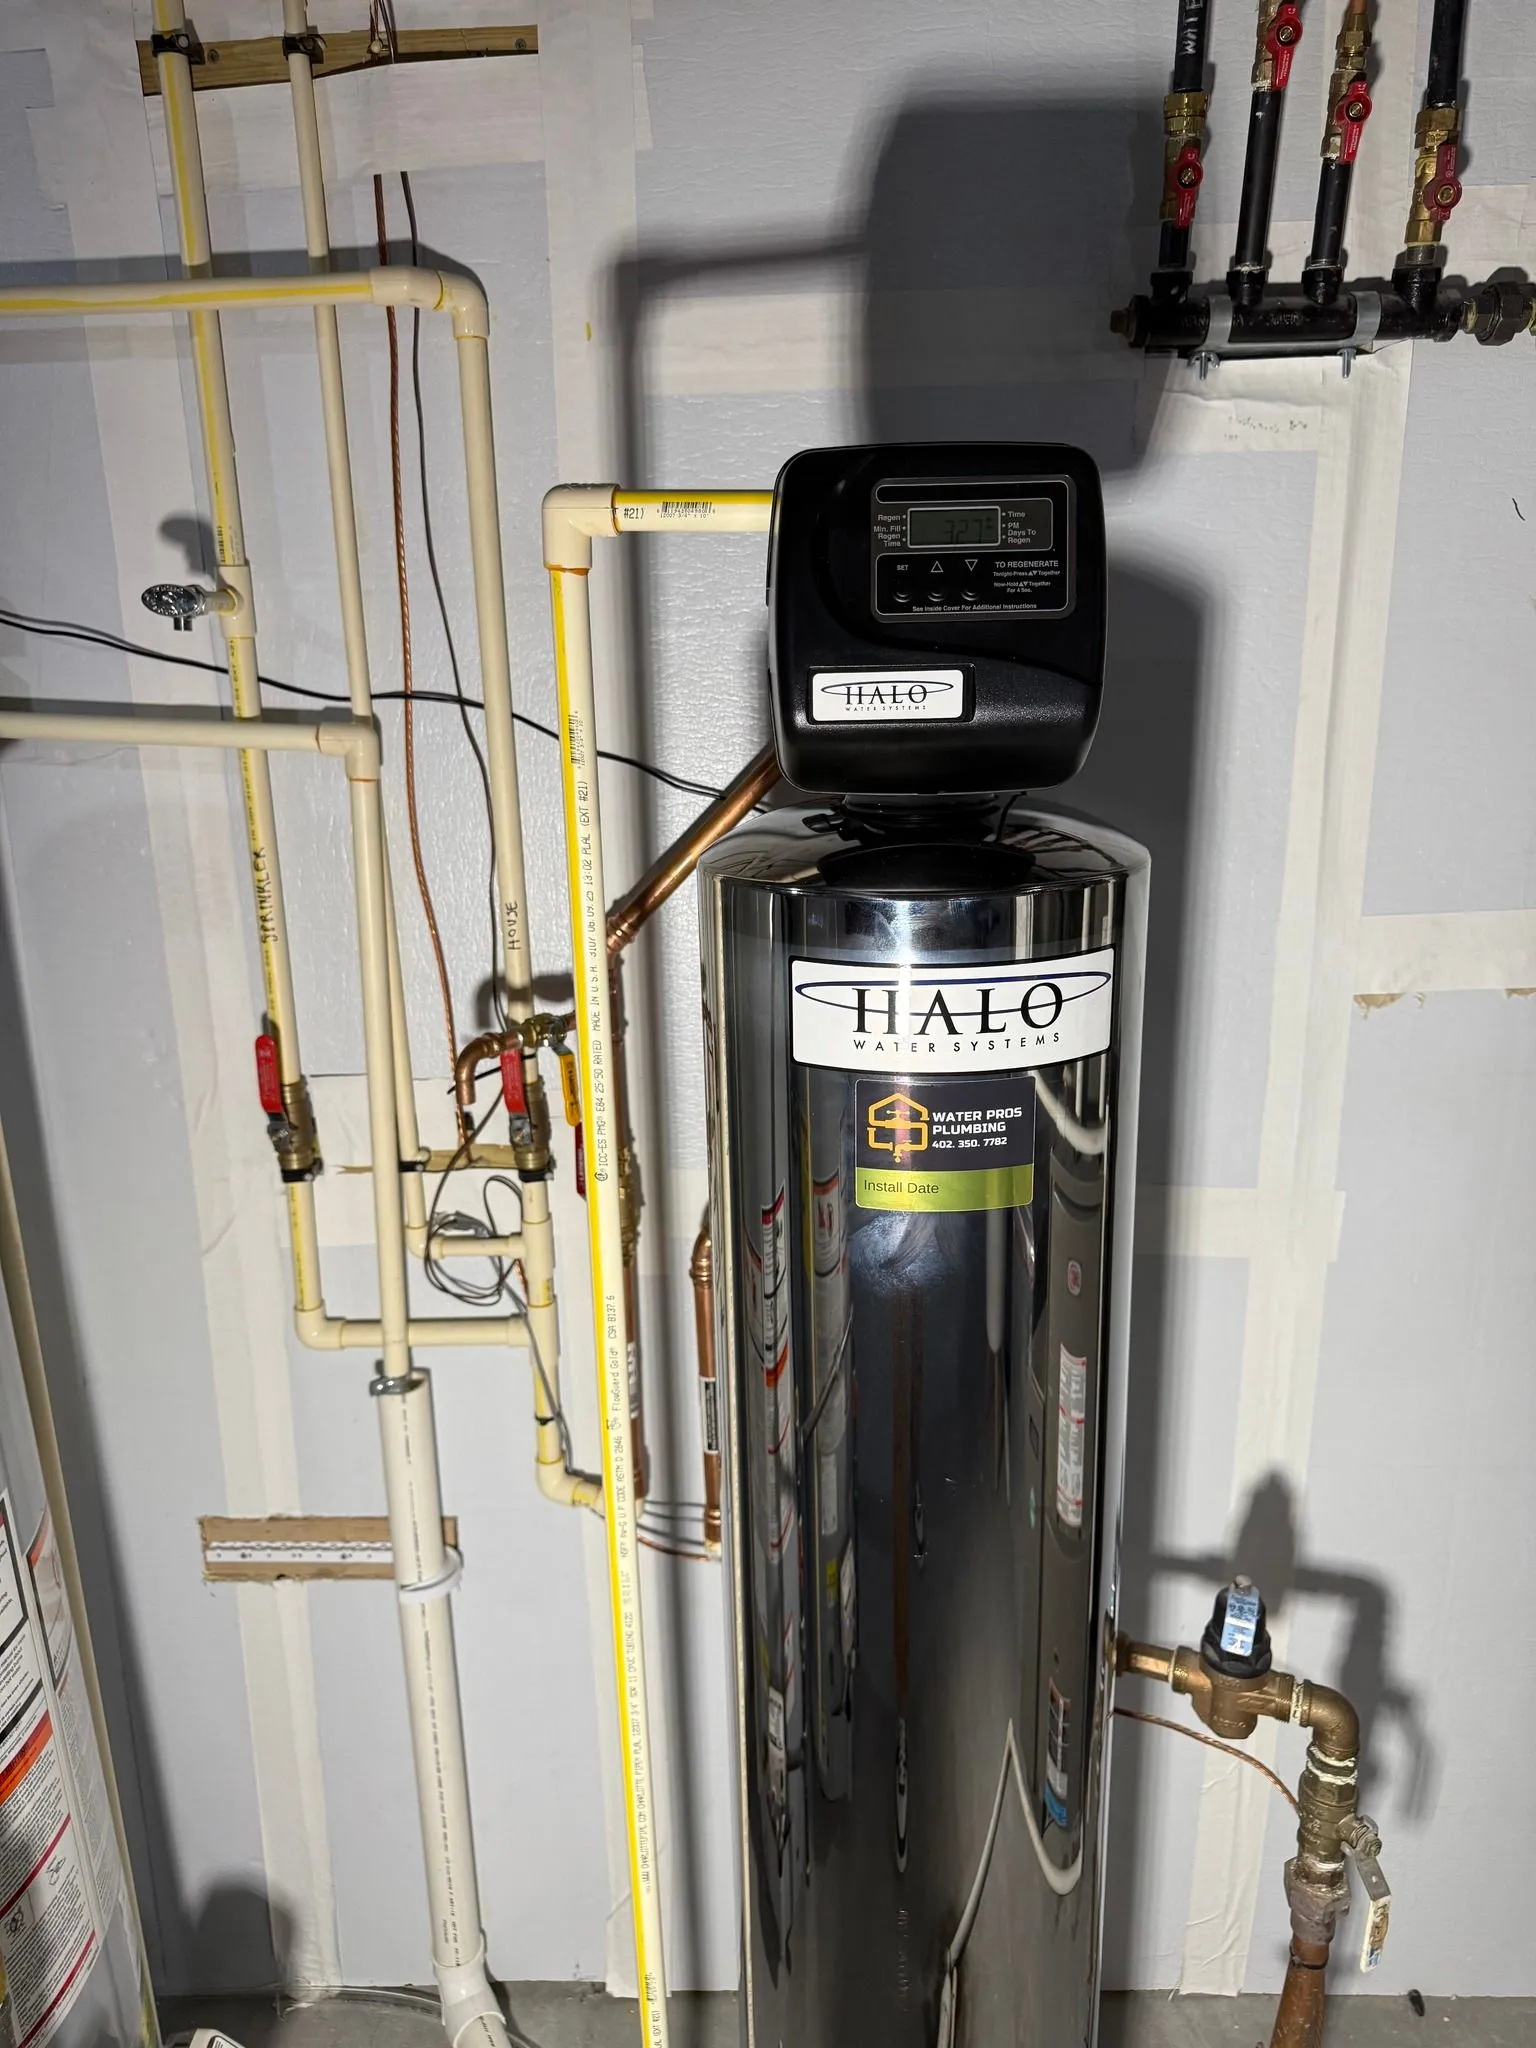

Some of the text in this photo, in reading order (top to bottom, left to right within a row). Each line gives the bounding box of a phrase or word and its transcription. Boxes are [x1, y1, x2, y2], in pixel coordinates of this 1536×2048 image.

[877, 513, 901, 522] Regen
[873, 525, 888, 533] Min.
[1007, 528, 1037, 537] Days To
[1007, 536, 1031, 545] Regen
[1007, 560, 1059, 568] REGENERATE
[1002, 602, 1038, 610] Instructions
[844, 684, 928, 705] HALO
[577, 781, 588, 801] #21)
[578, 806, 591, 827] (EXT
[581, 860, 592, 885] 13:02
[251, 846, 279, 945] SPRINKLER
[504, 900, 522, 952] HOUSE
[589, 996, 599, 1006] IN
[851, 982, 1064, 1036] HALO
[590, 1011, 601, 1031] MADE
[853, 1031, 1061, 1053] WATER SYSTEMS
[592, 1040, 602, 1065] RATED
[593, 1068, 604, 1094] 25/50
[594, 1098, 605, 1112] E84
[932, 1106, 1023, 1123] WATER PROS
[932, 1121, 1007, 1136] PLUMBING
[931, 1136, 1008, 1149] 402. 350. 7782
[597, 1139, 608, 1166] ICC-ES
[864, 1178, 940, 1195] Install Date
[607, 1325, 616, 1339] CSA
[611, 1372, 621, 1411] FlowGuard
